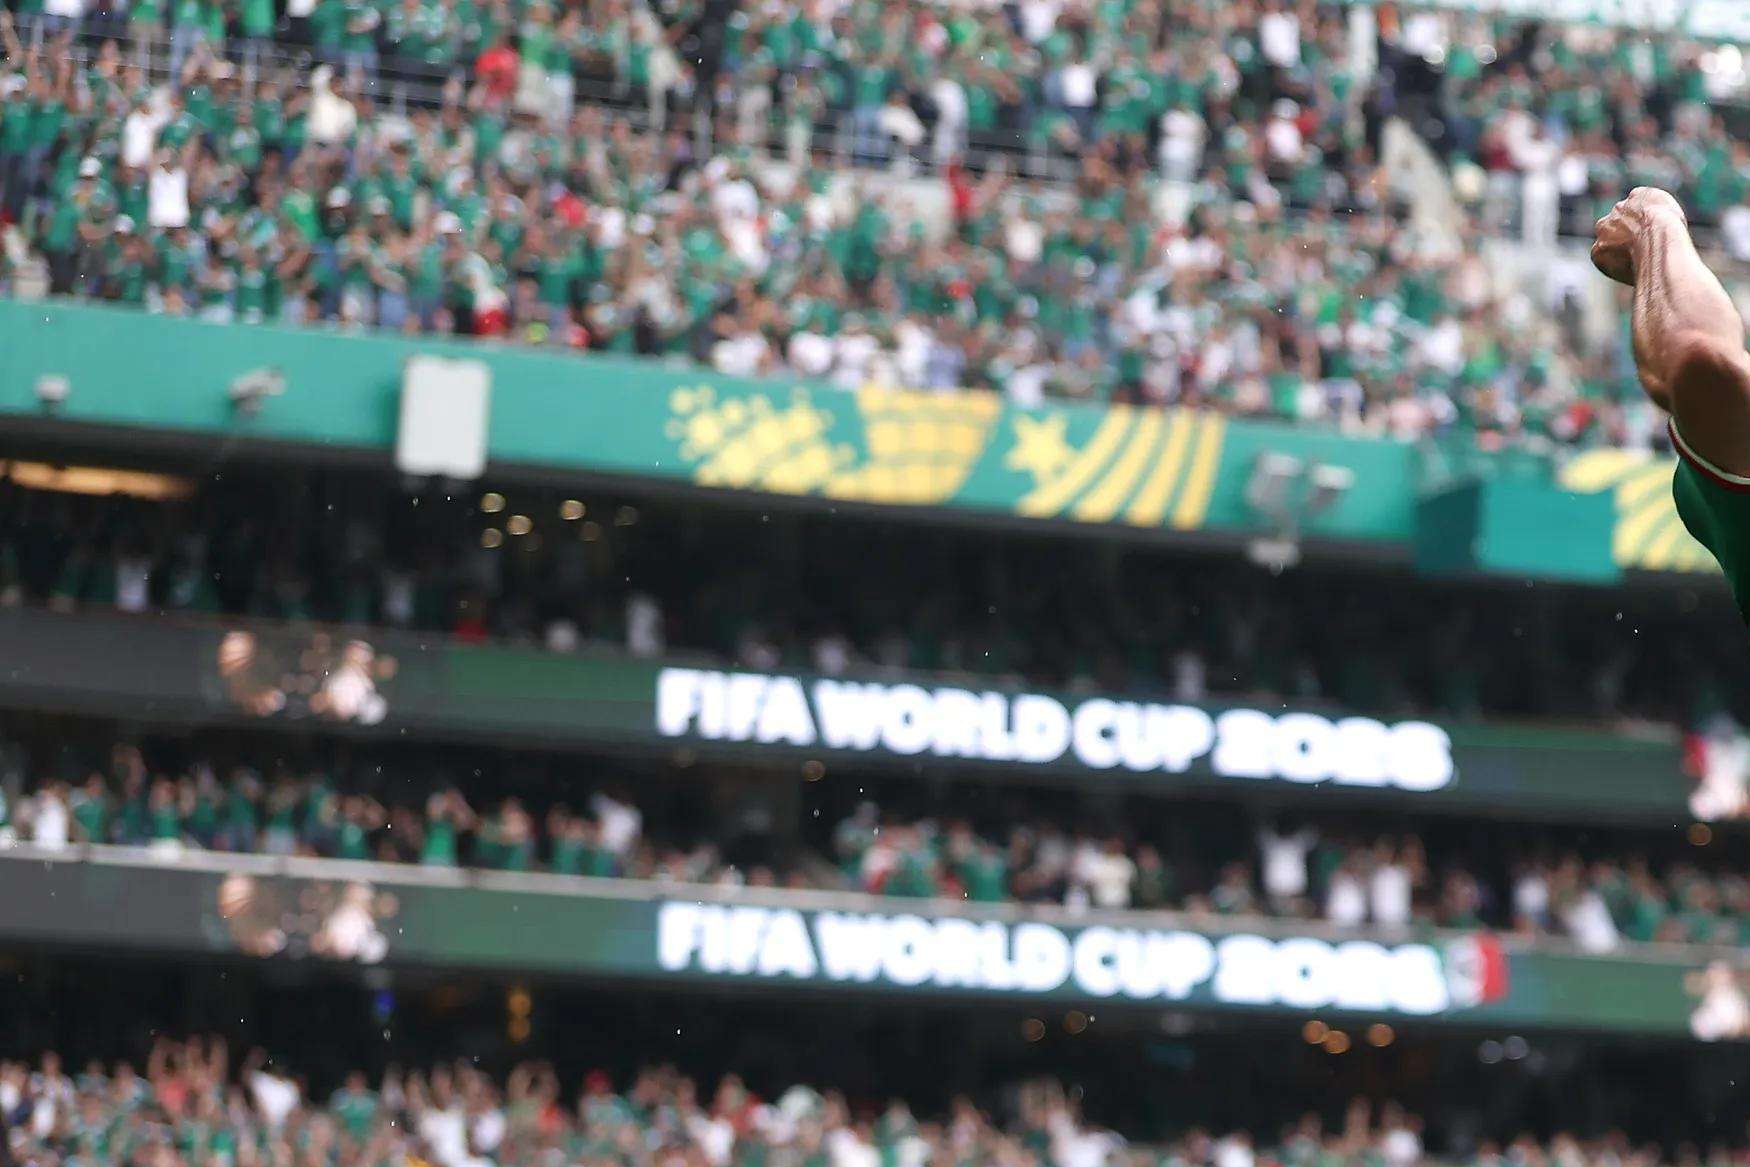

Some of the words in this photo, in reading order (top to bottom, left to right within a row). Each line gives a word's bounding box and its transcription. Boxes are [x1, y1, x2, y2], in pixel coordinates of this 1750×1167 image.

[656, 667, 815, 747] FIFA
[814, 678, 1071, 764] WORLD
[1073, 699, 1214, 773] CUP
[657, 902, 816, 978] FIFA
[815, 912, 1072, 994] WORLD
[1073, 928, 1215, 1001] CUP
